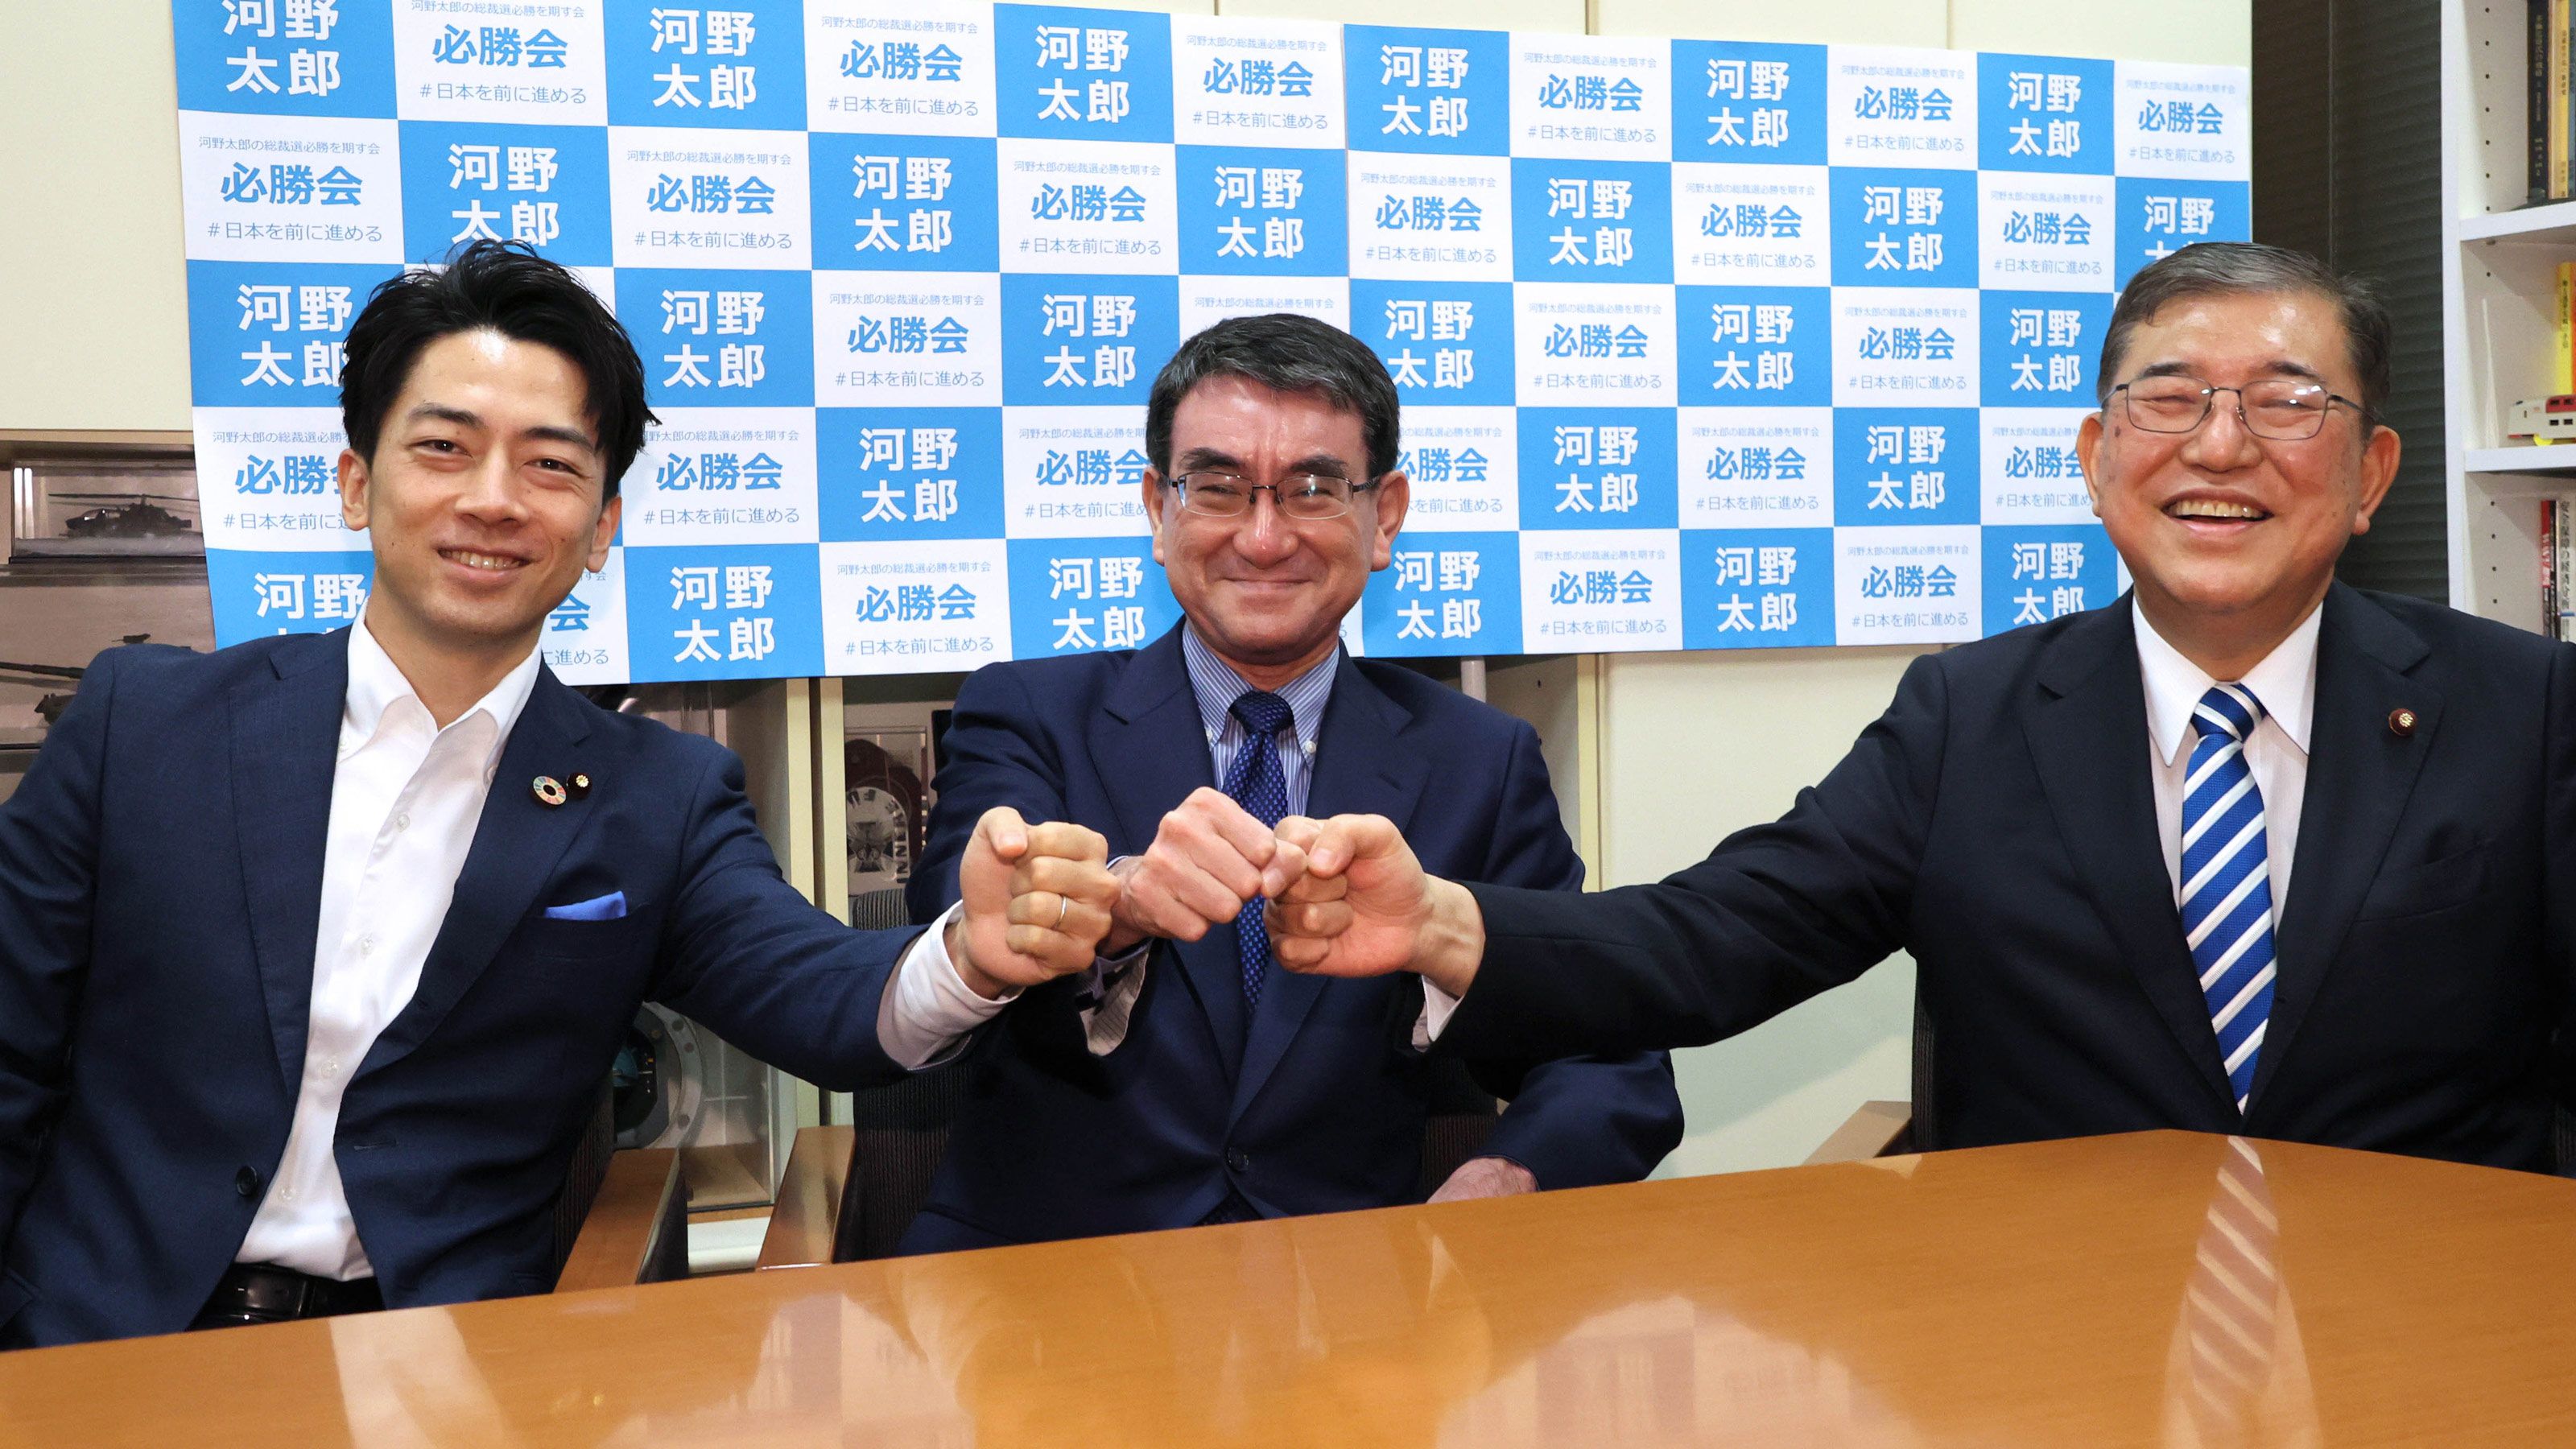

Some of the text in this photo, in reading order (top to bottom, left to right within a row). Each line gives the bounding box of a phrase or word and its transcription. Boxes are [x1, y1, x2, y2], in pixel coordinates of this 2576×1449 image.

[431, 23, 568, 68] 必勝会
[650, 7, 756, 56] 河野
[1035, 24, 1129, 72] 河野
[226, 46, 341, 97] 太郎
[840, 39, 963, 82] 必勝会
[1203, 57, 1314, 97] 必勝会
[1380, 44, 1469, 89] 河野
[1706, 58, 1790, 101] 河野
[652, 63, 757, 110] 太郎
[1037, 77, 1130, 123] 太郎
[1538, 73, 1643, 112] 必勝会
[1854, 85, 1953, 122] 必勝会
[2008, 71, 2081, 114] 河野
[1381, 94, 1468, 138] 太郎
[1707, 106, 1789, 148] 太郎
[2137, 99, 2223, 135] 必勝会
[2008, 117, 2081, 158] 太郎
[220, 162, 362, 206] 必勝会
[448, 143, 559, 192] 河野
[852, 154, 952, 201] 河野
[1214, 166, 1303, 210] 河野
[646, 173, 775, 215] 必勝会
[1030, 183, 1146, 223] 必勝会
[1375, 194, 1482, 232] 必勝会
[1547, 177, 1633, 220] 河野
[1863, 185, 1943, 226] 河野
[2144, 195, 2215, 235] 河野
[452, 199, 560, 247] 太郎
[854, 208, 952, 253] 太郎
[1216, 216, 1304, 259] 太郎
[1700, 203, 1802, 238] 必勝会
[2002, 210, 2091, 246] 必勝会
[1549, 225, 1633, 267] 太郎
[1864, 231, 1943, 271] 太郎
[237, 284, 353, 332] 河野
[660, 289, 765, 336] 河野
[1042, 294, 1136, 337] 河野
[1385, 299, 1474, 341] 河野
[1711, 303, 1794, 344] 河野
[2009, 308, 2081, 348] 河野
[847, 315, 969, 354] 必勝会
[1544, 323, 1649, 358] 必勝会
[1858, 326, 1955, 361] 必勝会
[663, 343, 766, 388] 太郎
[1042, 344, 1136, 388] 太郎
[1386, 347, 1474, 390] 太郎
[1712, 349, 1794, 390] 太郎
[2010, 353, 2081, 392] 太郎
[859, 427, 958, 472] 河野
[1553, 425, 1639, 466] 河野
[1706, 446, 1806, 481] 必勝会
[1866, 425, 1946, 464] 河野
[235, 454, 341, 495] 必勝
[656, 452, 783, 491] 必勝会
[1554, 472, 1638, 513] 太郎
[1867, 470, 1946, 510] 太郎
[861, 478, 958, 522] 太郎
[1048, 557, 1144, 600] 河野
[1393, 551, 1481, 592] 河野
[1715, 546, 1797, 586] 河野
[1861, 564, 1957, 599] 必勝会
[2012, 542, 2084, 580] 河野
[254, 572, 366, 619] 河野
[670, 564, 774, 610] 河野
[856, 583, 976, 622] 必勝会
[1550, 569, 1653, 605] 必勝会
[1052, 605, 1146, 650] 太郎
[1396, 597, 1482, 639] 太郎
[1717, 592, 1798, 632] 太郎
[673, 617, 775, 663] 太郎
